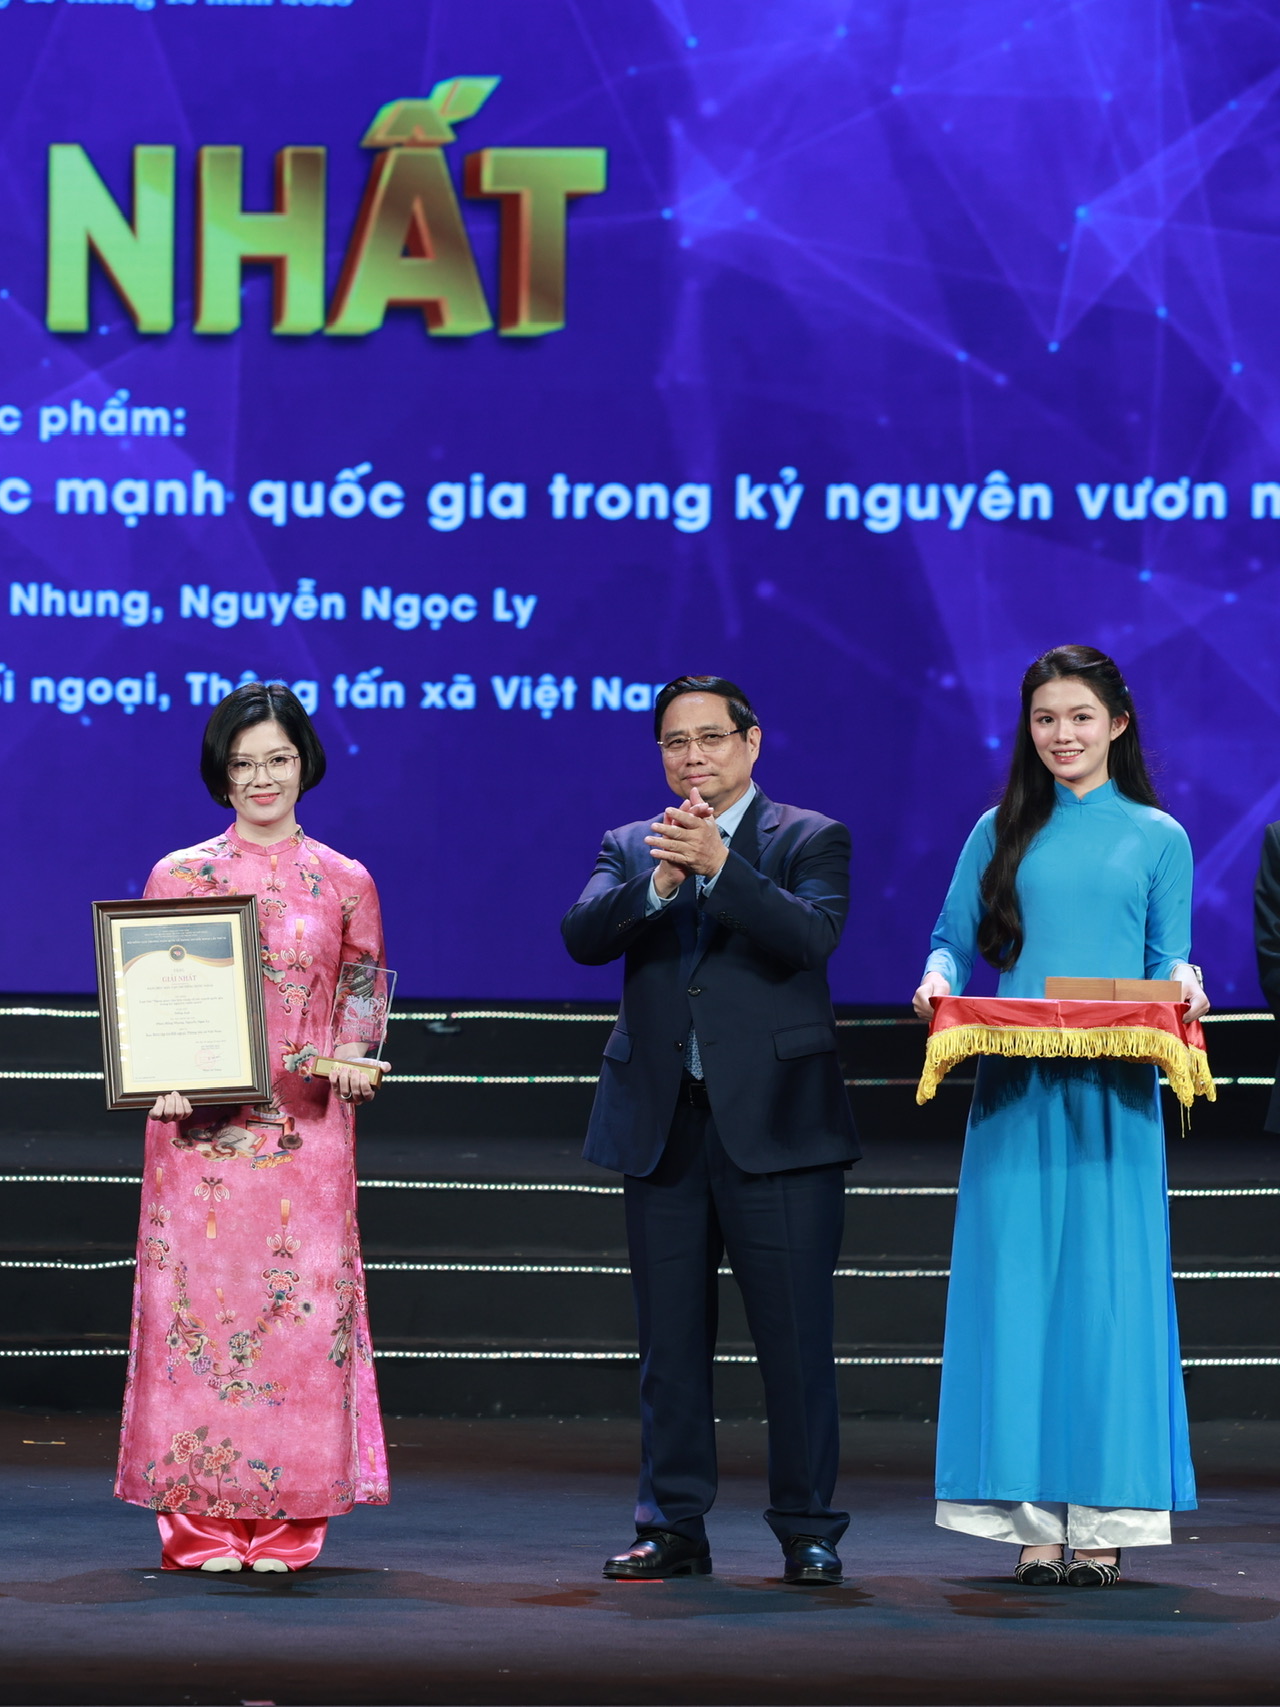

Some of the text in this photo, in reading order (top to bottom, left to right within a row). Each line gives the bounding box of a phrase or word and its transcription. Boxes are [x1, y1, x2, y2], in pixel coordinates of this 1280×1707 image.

[46, 75, 608, 338] NHẤT
[39, 388, 186, 441] phẩm:
[55, 469, 226, 528] mạnh
[248, 462, 404, 527] quốc
[427, 472, 526, 532] gia
[548, 473, 711, 533] trong
[735, 466, 804, 530] kỷ
[826, 470, 1053, 534] nguyên
[1076, 475, 1227, 521] vươn
[9, 582, 164, 627] Nhung,
[180, 577, 346, 628] Nguyễn
[361, 586, 477, 630] Ngọc
[493, 587, 537, 629] Ly
[30, 671, 170, 715] ngoại,
[185, 670, 319, 717] Thg
[333, 669, 405, 709] tấn
[421, 674, 476, 710] xã
[491, 673, 578, 719] Việt
[592, 676, 670, 712] Na
